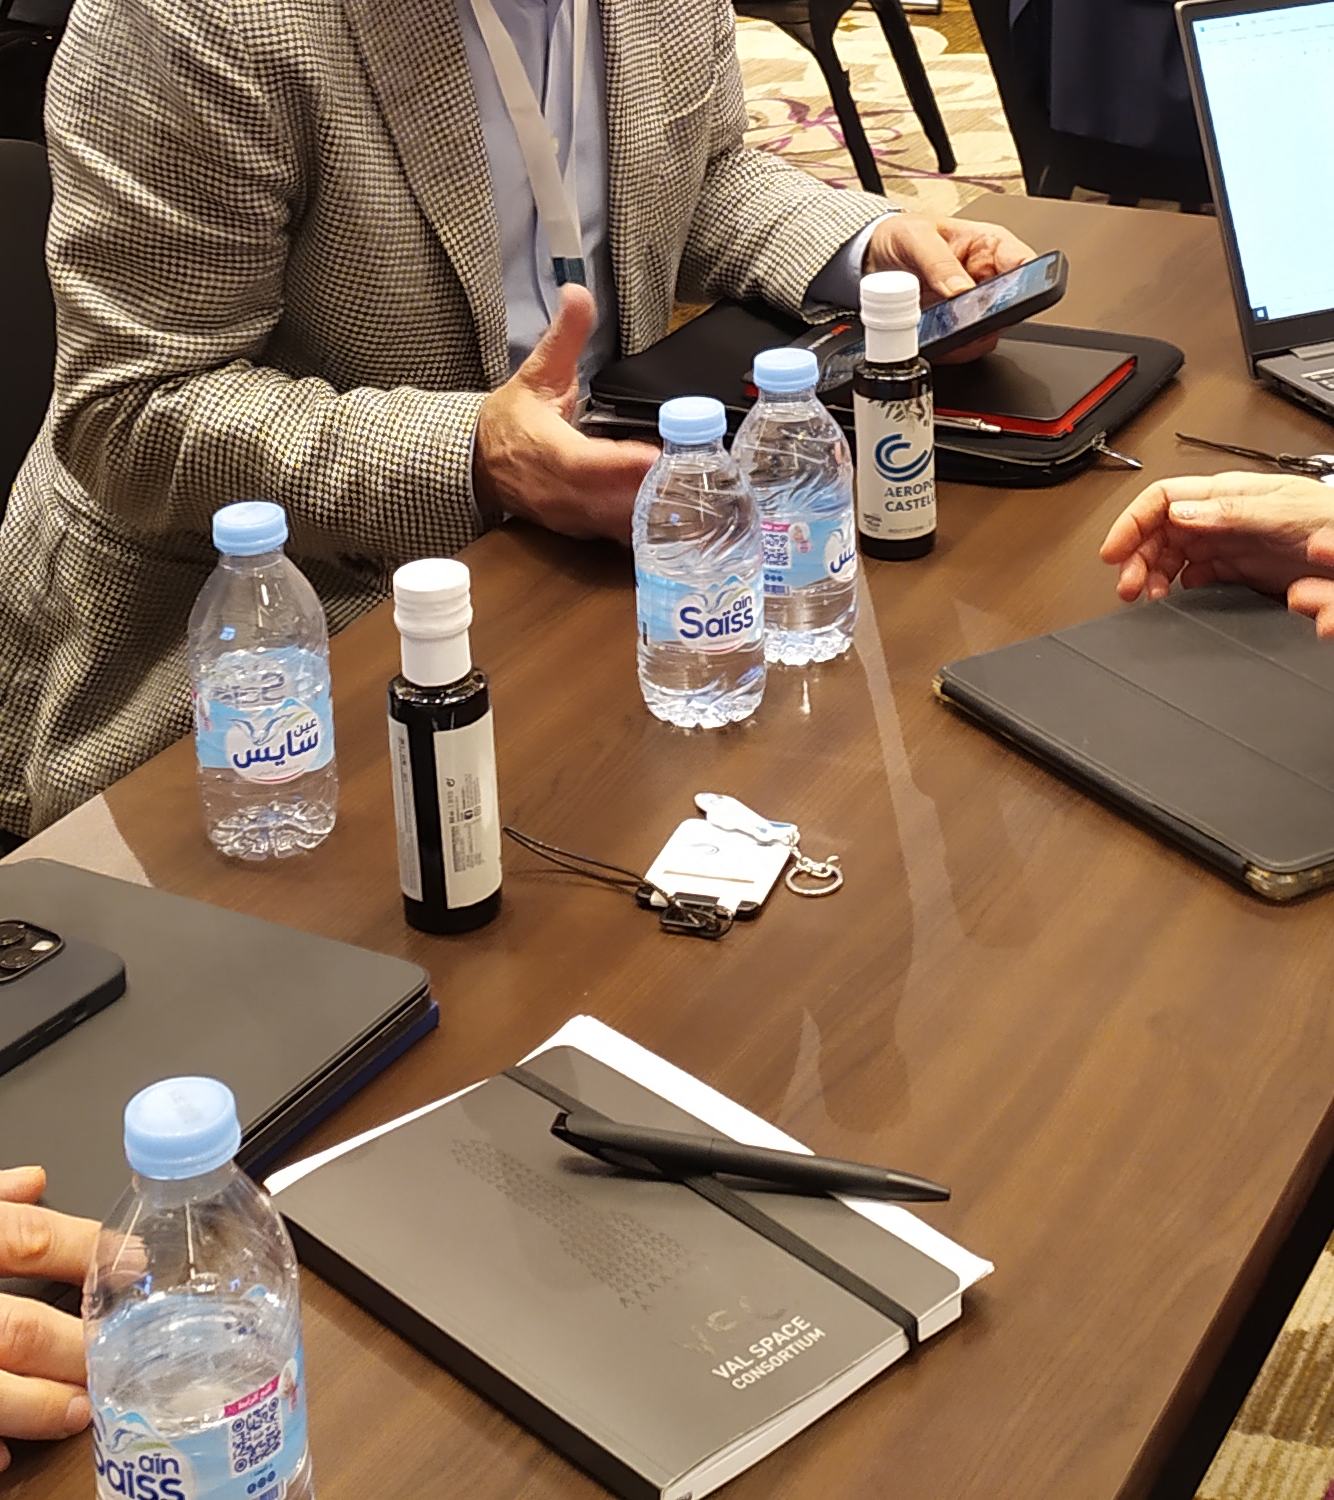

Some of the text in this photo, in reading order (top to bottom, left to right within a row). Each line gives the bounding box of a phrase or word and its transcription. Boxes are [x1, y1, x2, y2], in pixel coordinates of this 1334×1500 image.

[679, 606, 754, 639] Saïss
[293, 717, 318, 737] عين
[232, 730, 319, 769] سايس
[711, 1315, 811, 1379] VAL SPACE
[731, 1327, 827, 1390] CONSORTIUM
